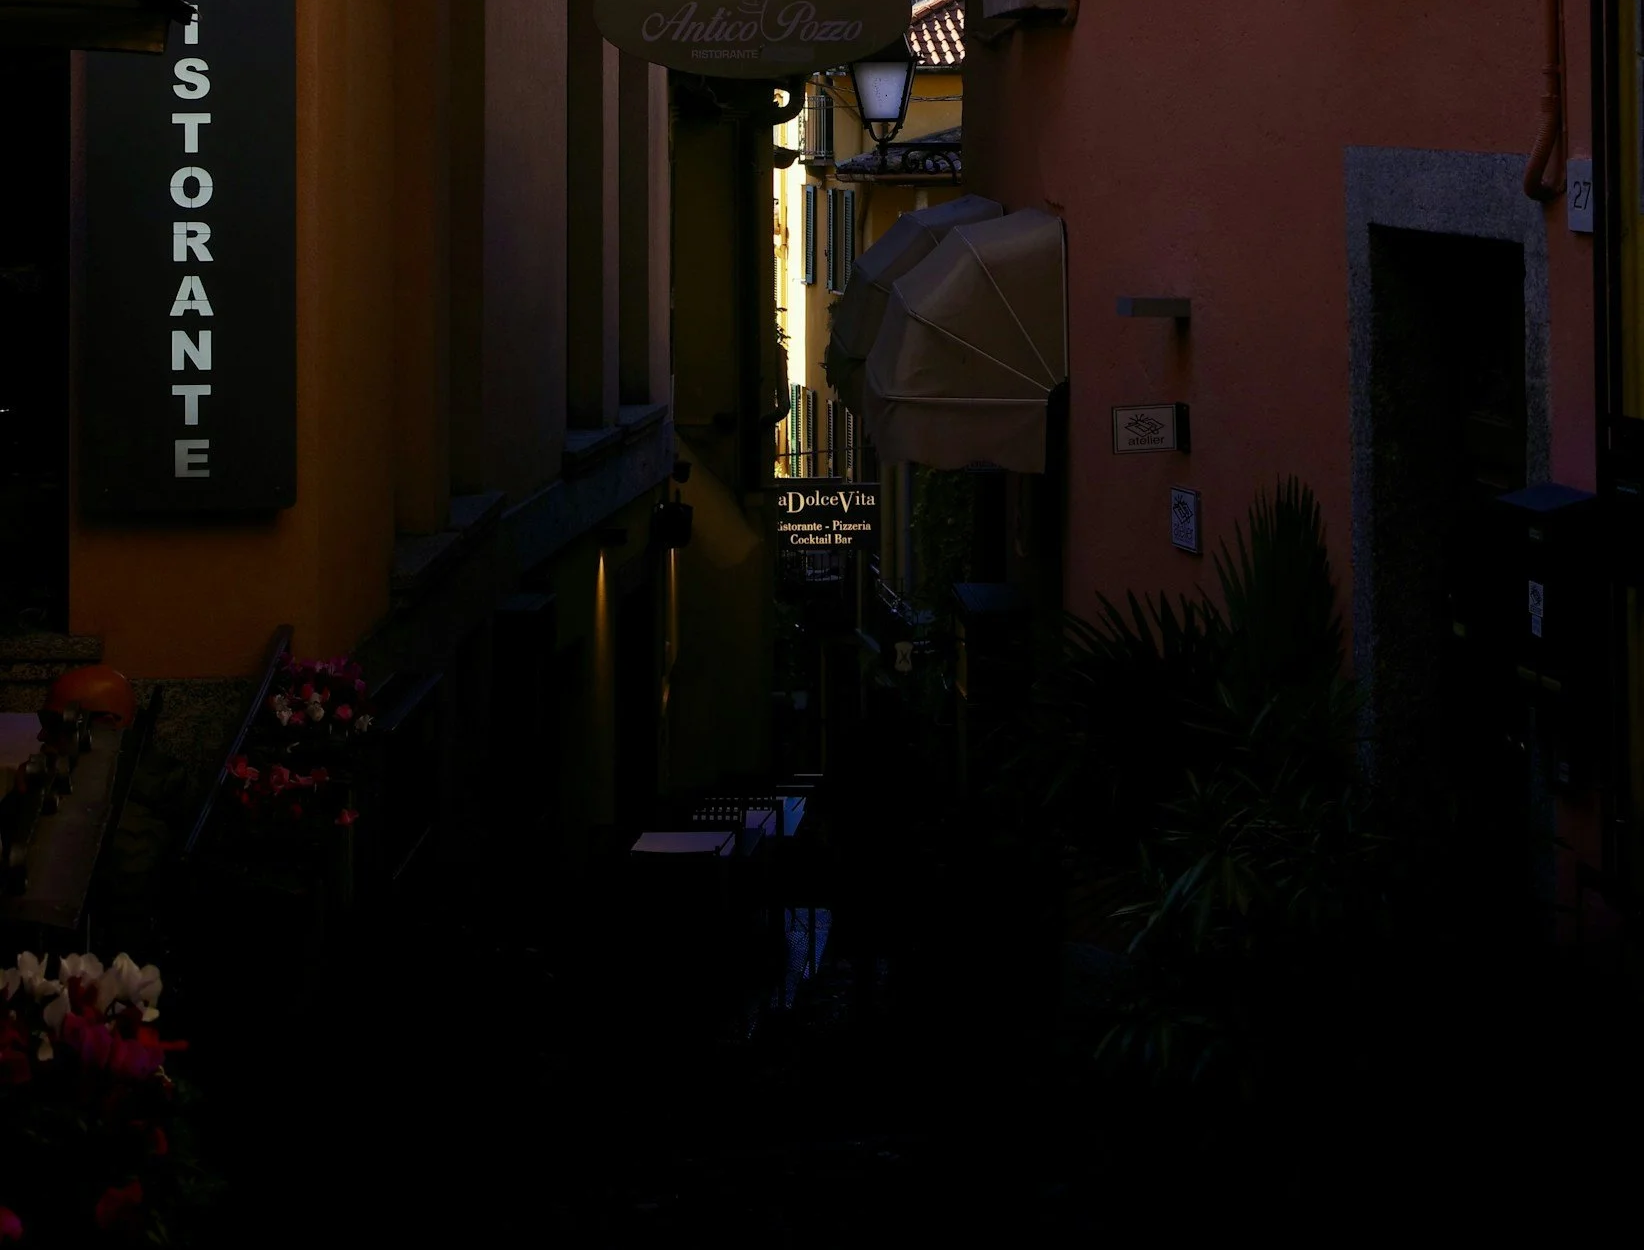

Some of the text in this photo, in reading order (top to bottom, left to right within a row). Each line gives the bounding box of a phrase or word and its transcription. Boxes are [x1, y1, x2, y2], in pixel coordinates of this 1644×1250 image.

[641, 1, 863, 42] Antico Pozzo
[691, 49, 759, 59] RISTORANTE
[1573, 181, 1591, 210] 27
[1128, 436, 1165, 446] atelier
[777, 521, 822, 531] istorante
[832, 520, 871, 530] Pizzeria
[790, 534, 852, 544] Cocktail Bar
